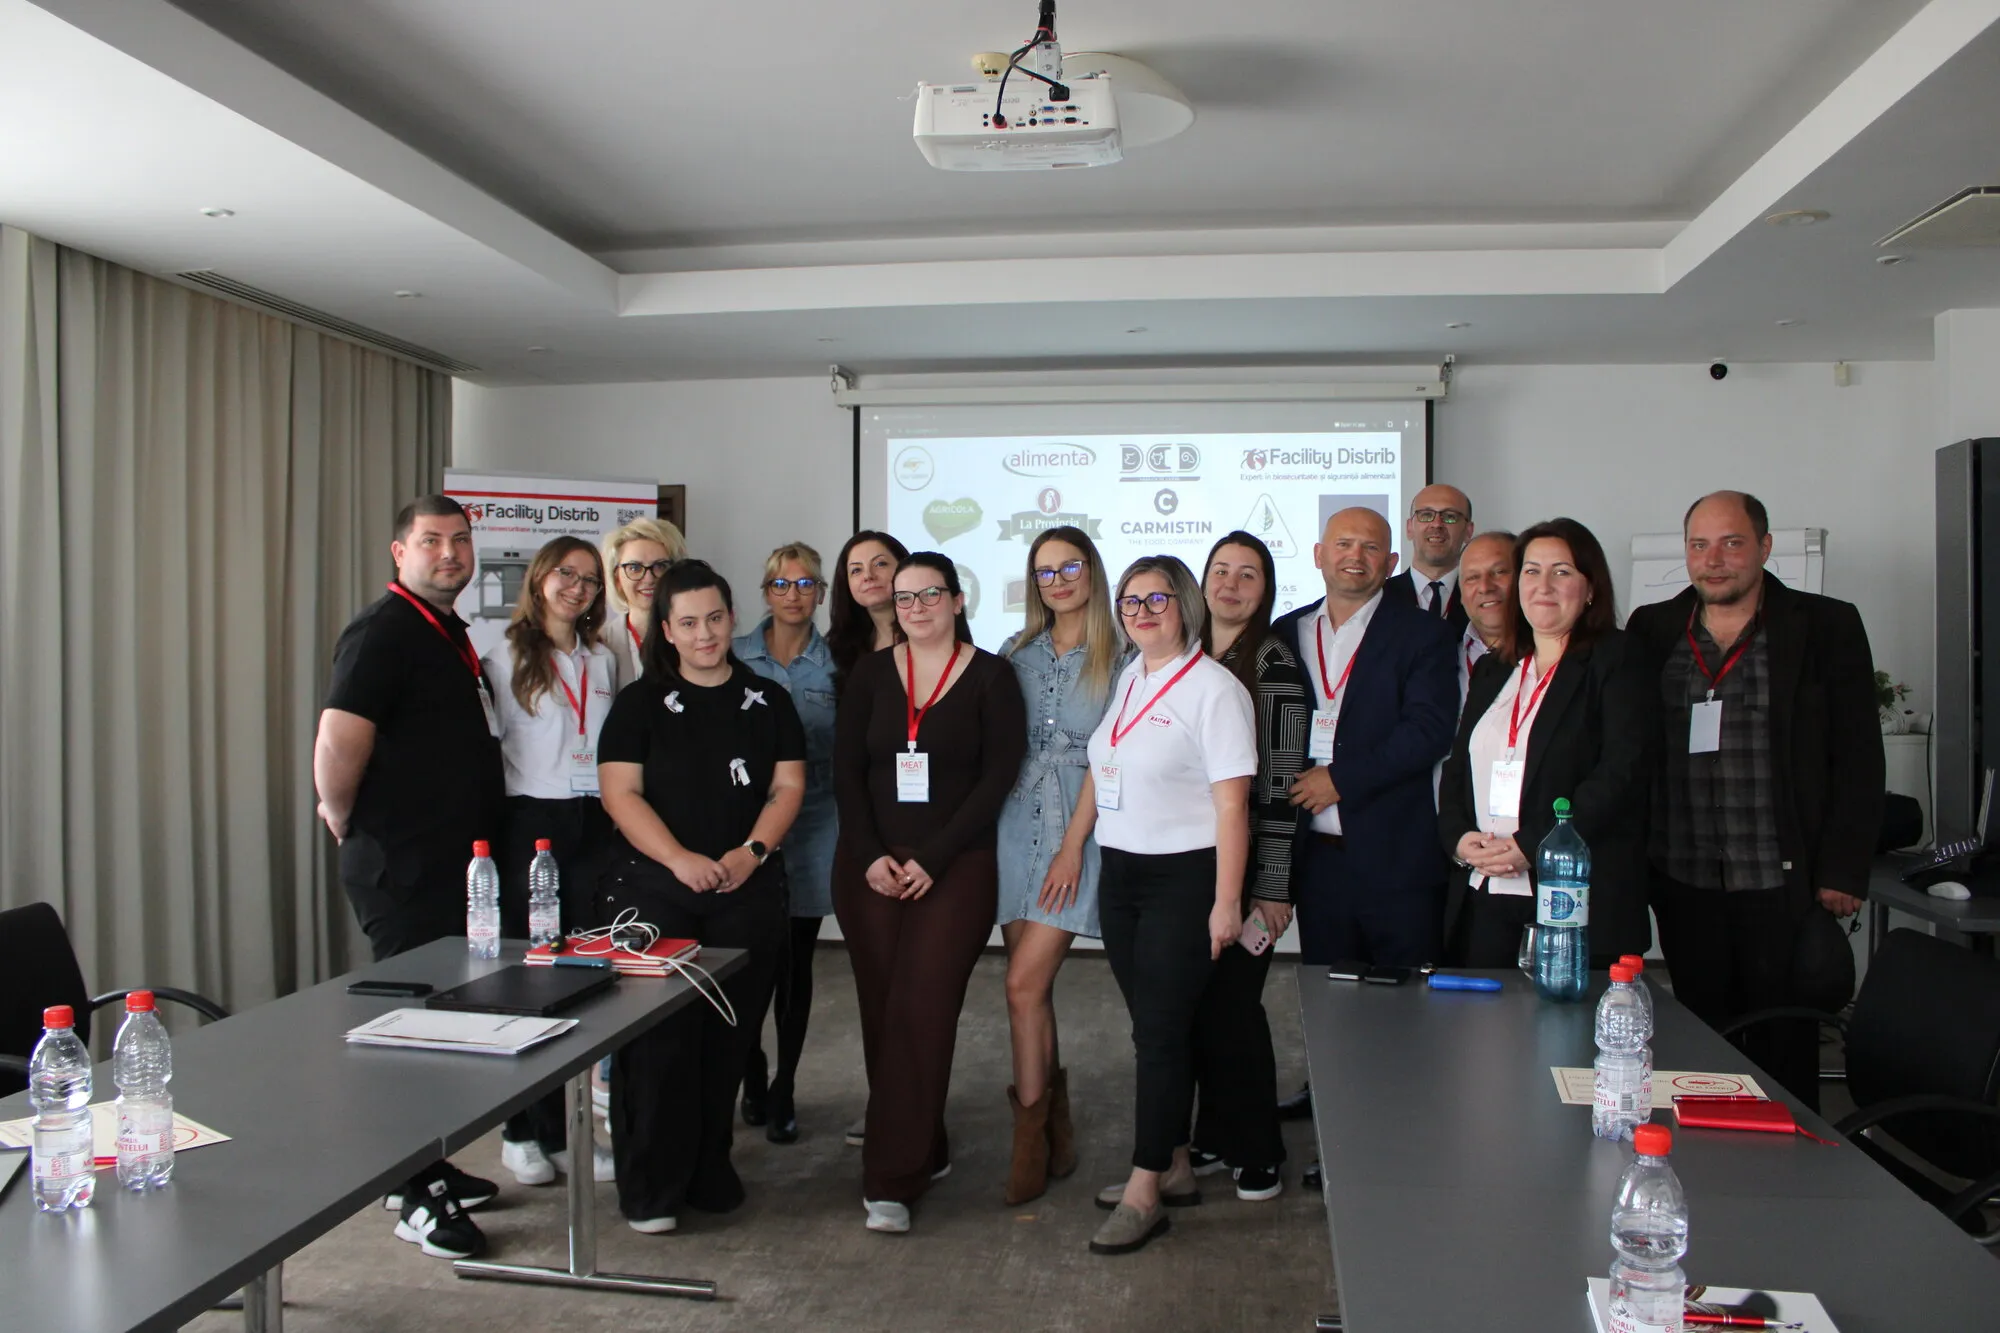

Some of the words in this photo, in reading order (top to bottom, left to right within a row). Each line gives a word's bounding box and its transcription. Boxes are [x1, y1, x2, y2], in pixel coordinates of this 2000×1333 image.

[1010, 449, 1089, 468] alimenta
[1270, 448, 1332, 469] Facility
[1338, 447, 1395, 465] Distrib
[485, 503, 543, 524] Facility
[548, 505, 600, 522] Distrib
[929, 504, 976, 514] AGRICOLA
[1020, 519, 1032, 530] La
[1120, 521, 1212, 535] CARMISTIN
[572, 753, 593, 762] MEAT
[900, 760, 923, 769] MEAT
[1101, 766, 1119, 777] MEAT
[1495, 769, 1517, 779] MEAT
